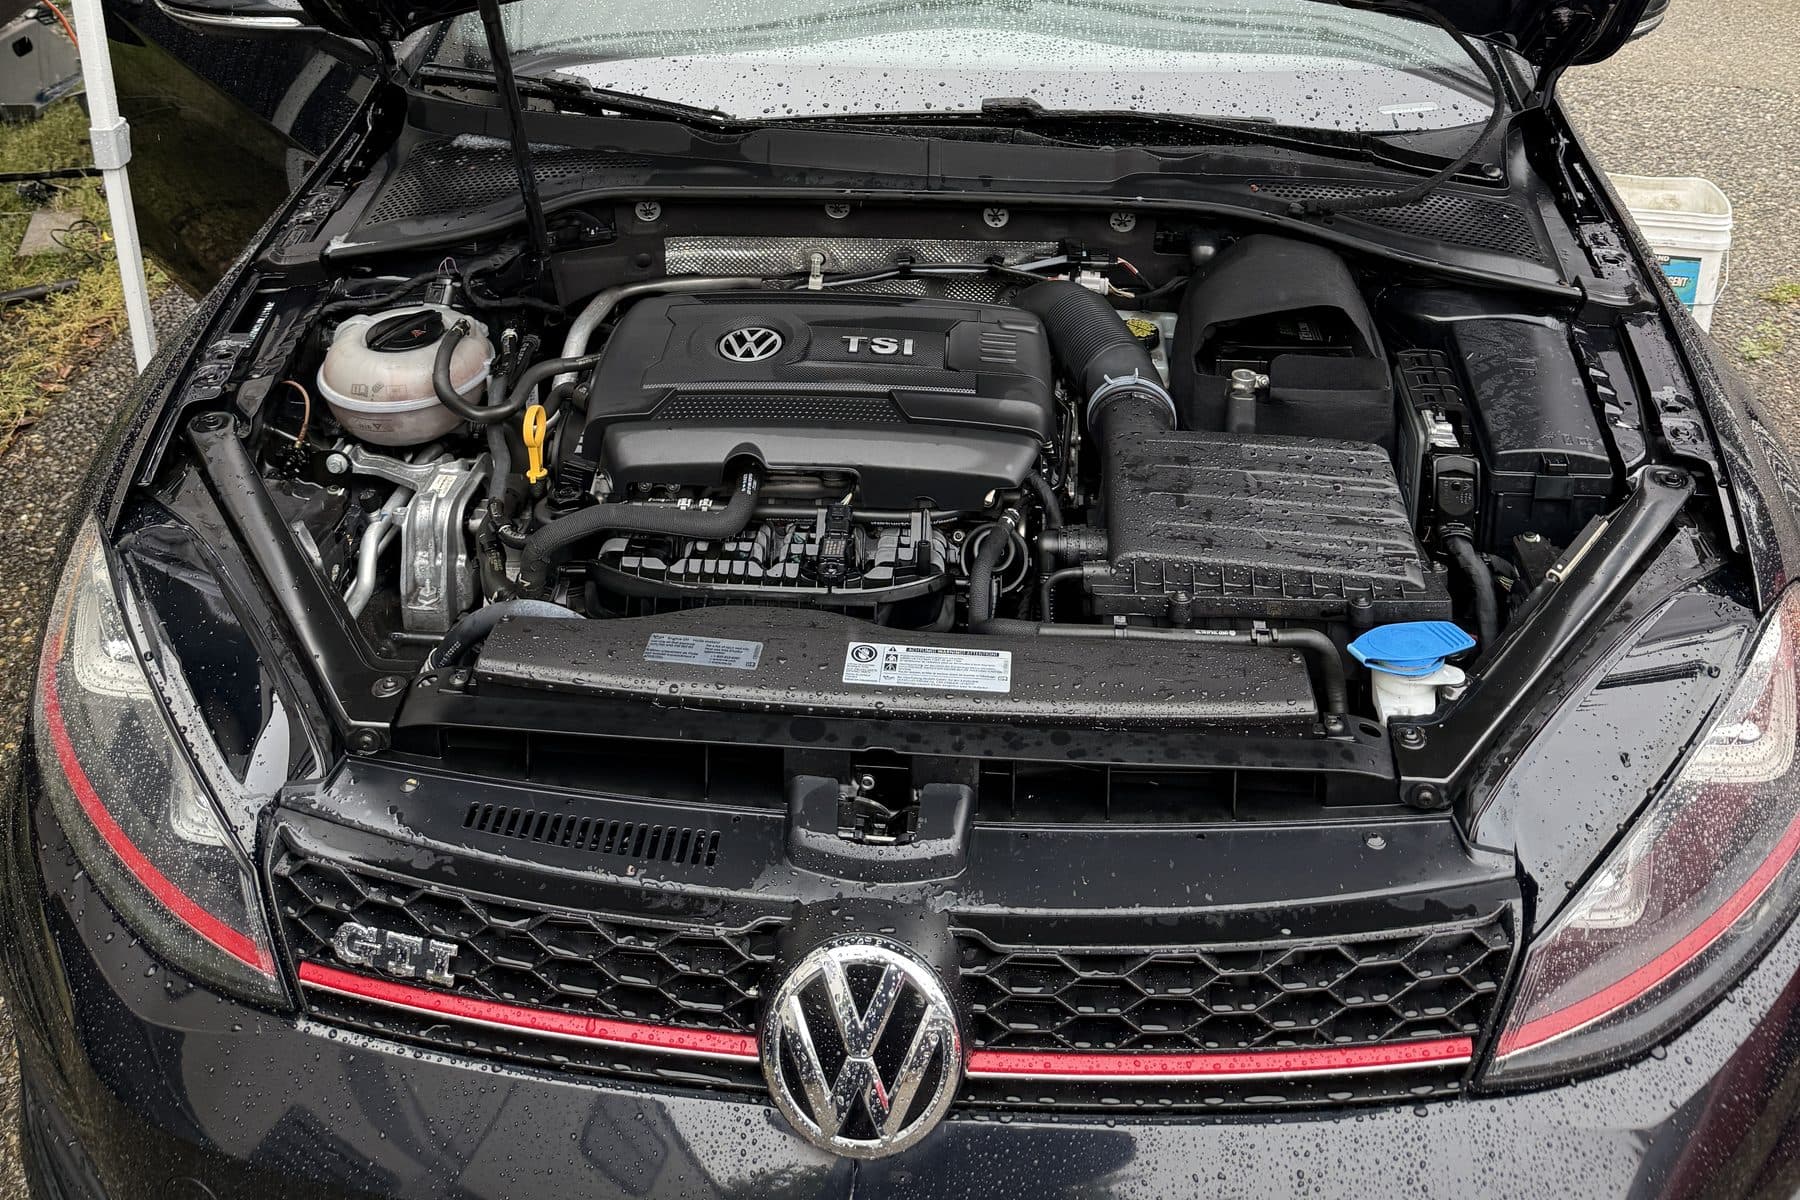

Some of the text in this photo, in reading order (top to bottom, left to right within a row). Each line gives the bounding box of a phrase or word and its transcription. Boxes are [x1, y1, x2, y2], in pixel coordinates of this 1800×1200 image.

[842, 335, 914, 356] TSI
[334, 922, 458, 988] GTI
[763, 936, 962, 1158] VW
